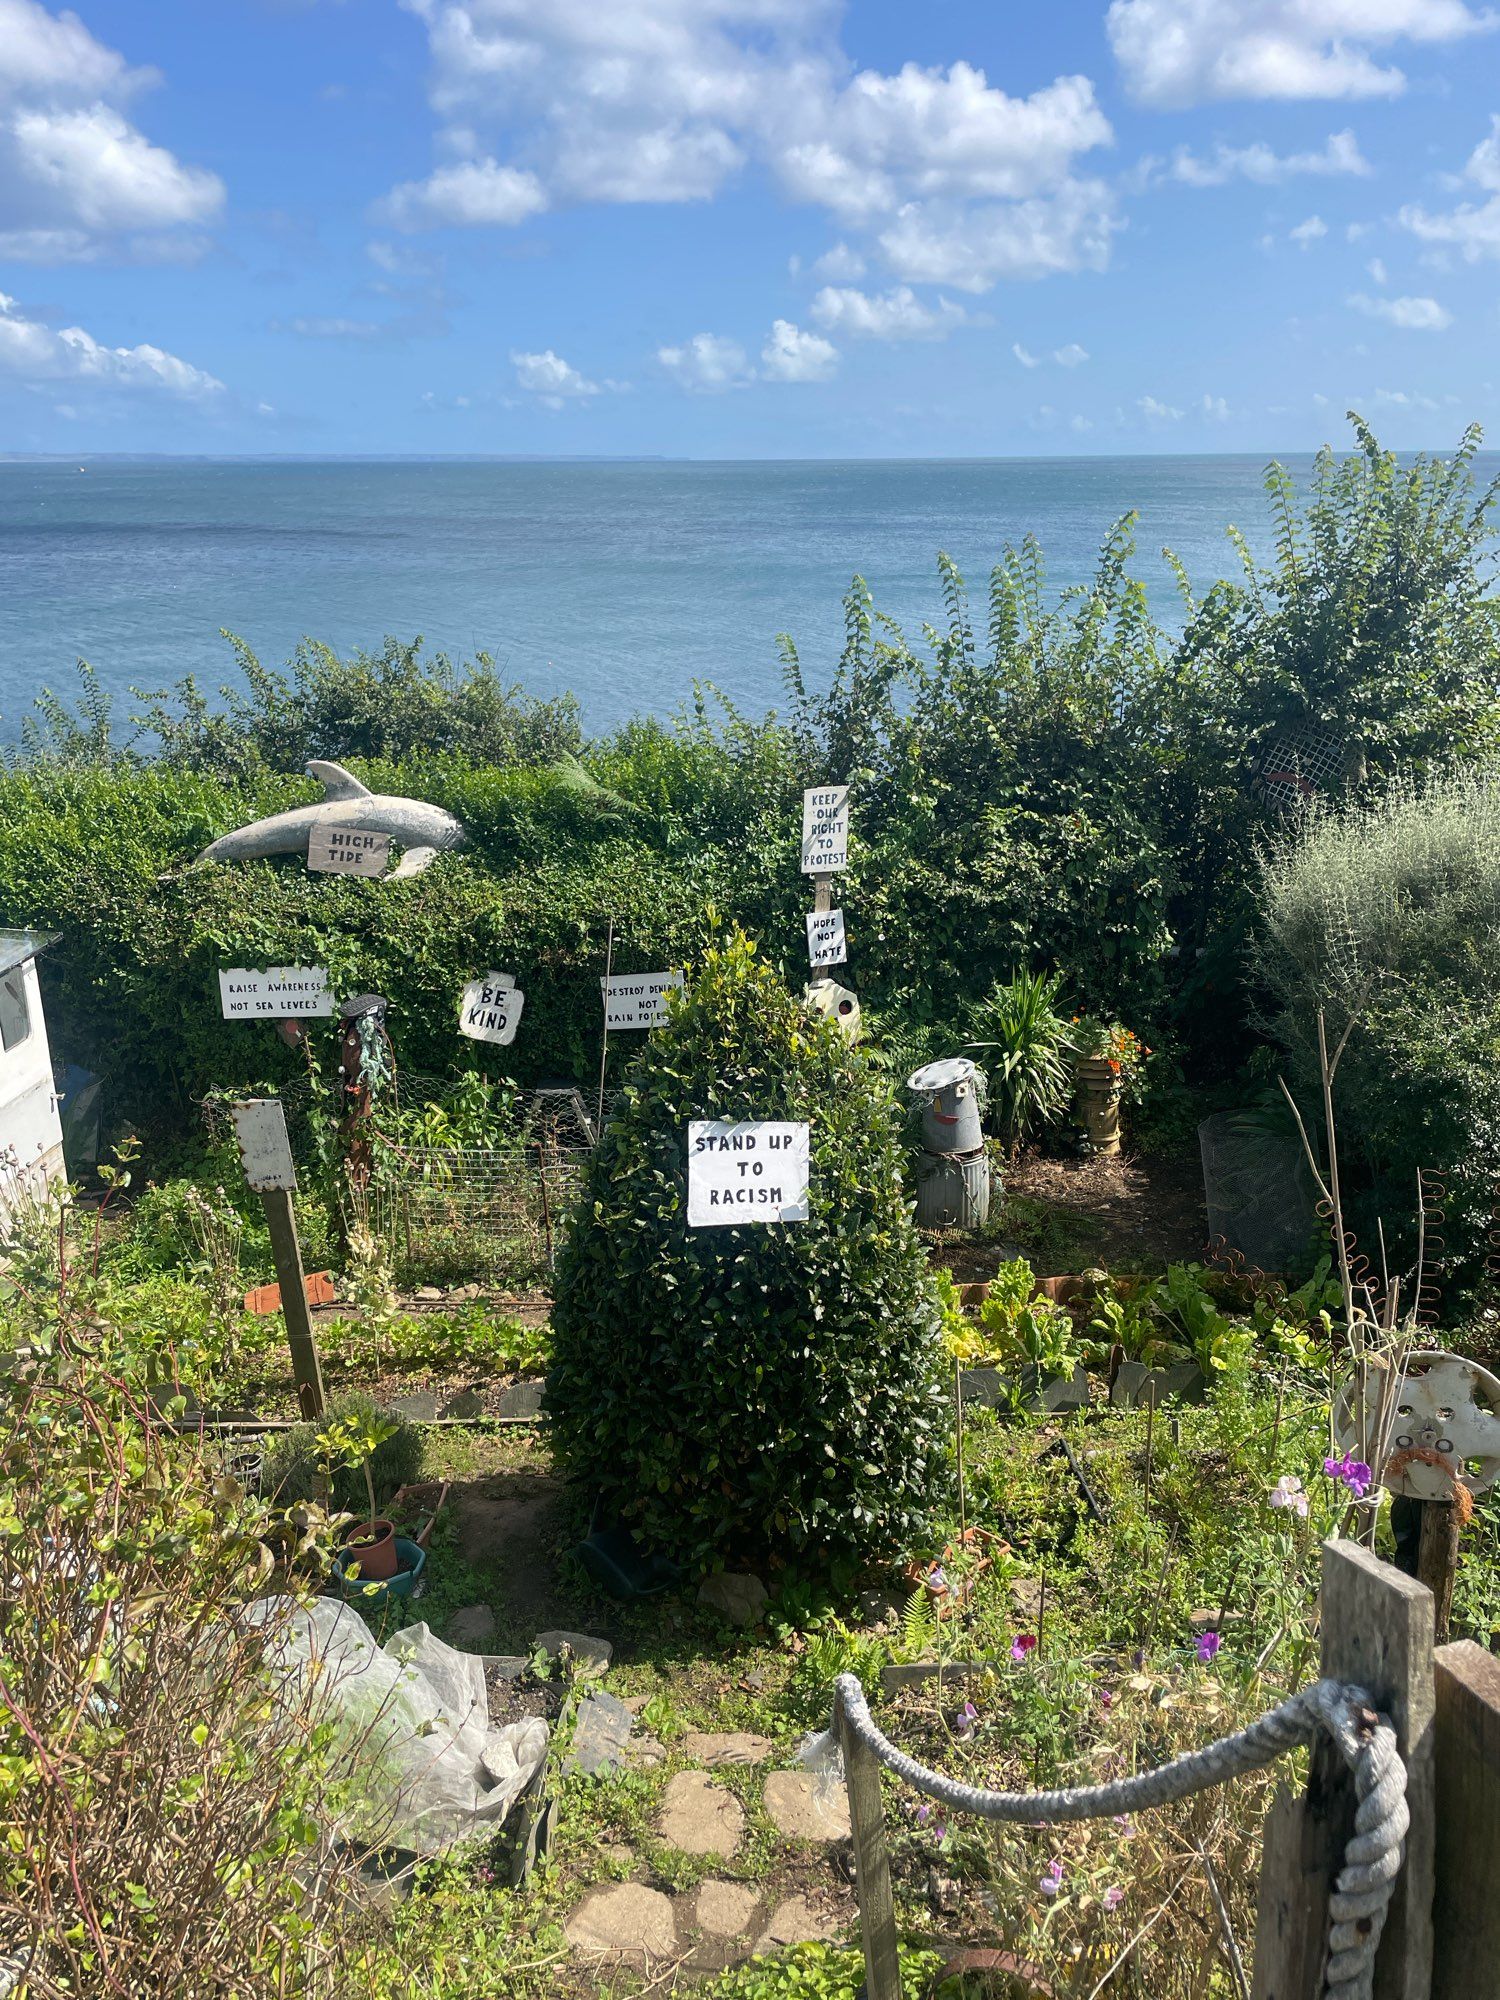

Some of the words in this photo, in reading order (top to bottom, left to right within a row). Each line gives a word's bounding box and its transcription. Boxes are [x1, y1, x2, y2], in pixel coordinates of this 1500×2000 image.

[812, 794, 838, 806] KEEP
[817, 807, 839, 819] OUR
[811, 822, 844, 835] RIGHT
[331, 833, 374, 849] HIGH
[818, 838, 833, 849] TO
[328, 849, 363, 864] TIDE
[804, 853, 845, 866] PROTEST
[813, 918, 836, 929] HOPE
[817, 931, 836, 942] NOT
[814, 946, 842, 959] HATE
[229, 983, 258, 993] RAISE
[267, 982, 321, 992] AWARENESS
[607, 985, 645, 997] DESTROY
[481, 987, 507, 1007] BE
[230, 1002, 248, 1011] NOT
[255, 1001, 274, 1010] SEA
[280, 1001, 318, 1010] LEVELS
[638, 1000, 658, 1009] NOT
[468, 1008, 507, 1031] KIND
[607, 1014, 633, 1022] RAIN
[695, 1135, 757, 1152] STAND
[769, 1135, 793, 1150] UP
[737, 1161, 763, 1177] TO
[710, 1187, 782, 1205] RACISM
